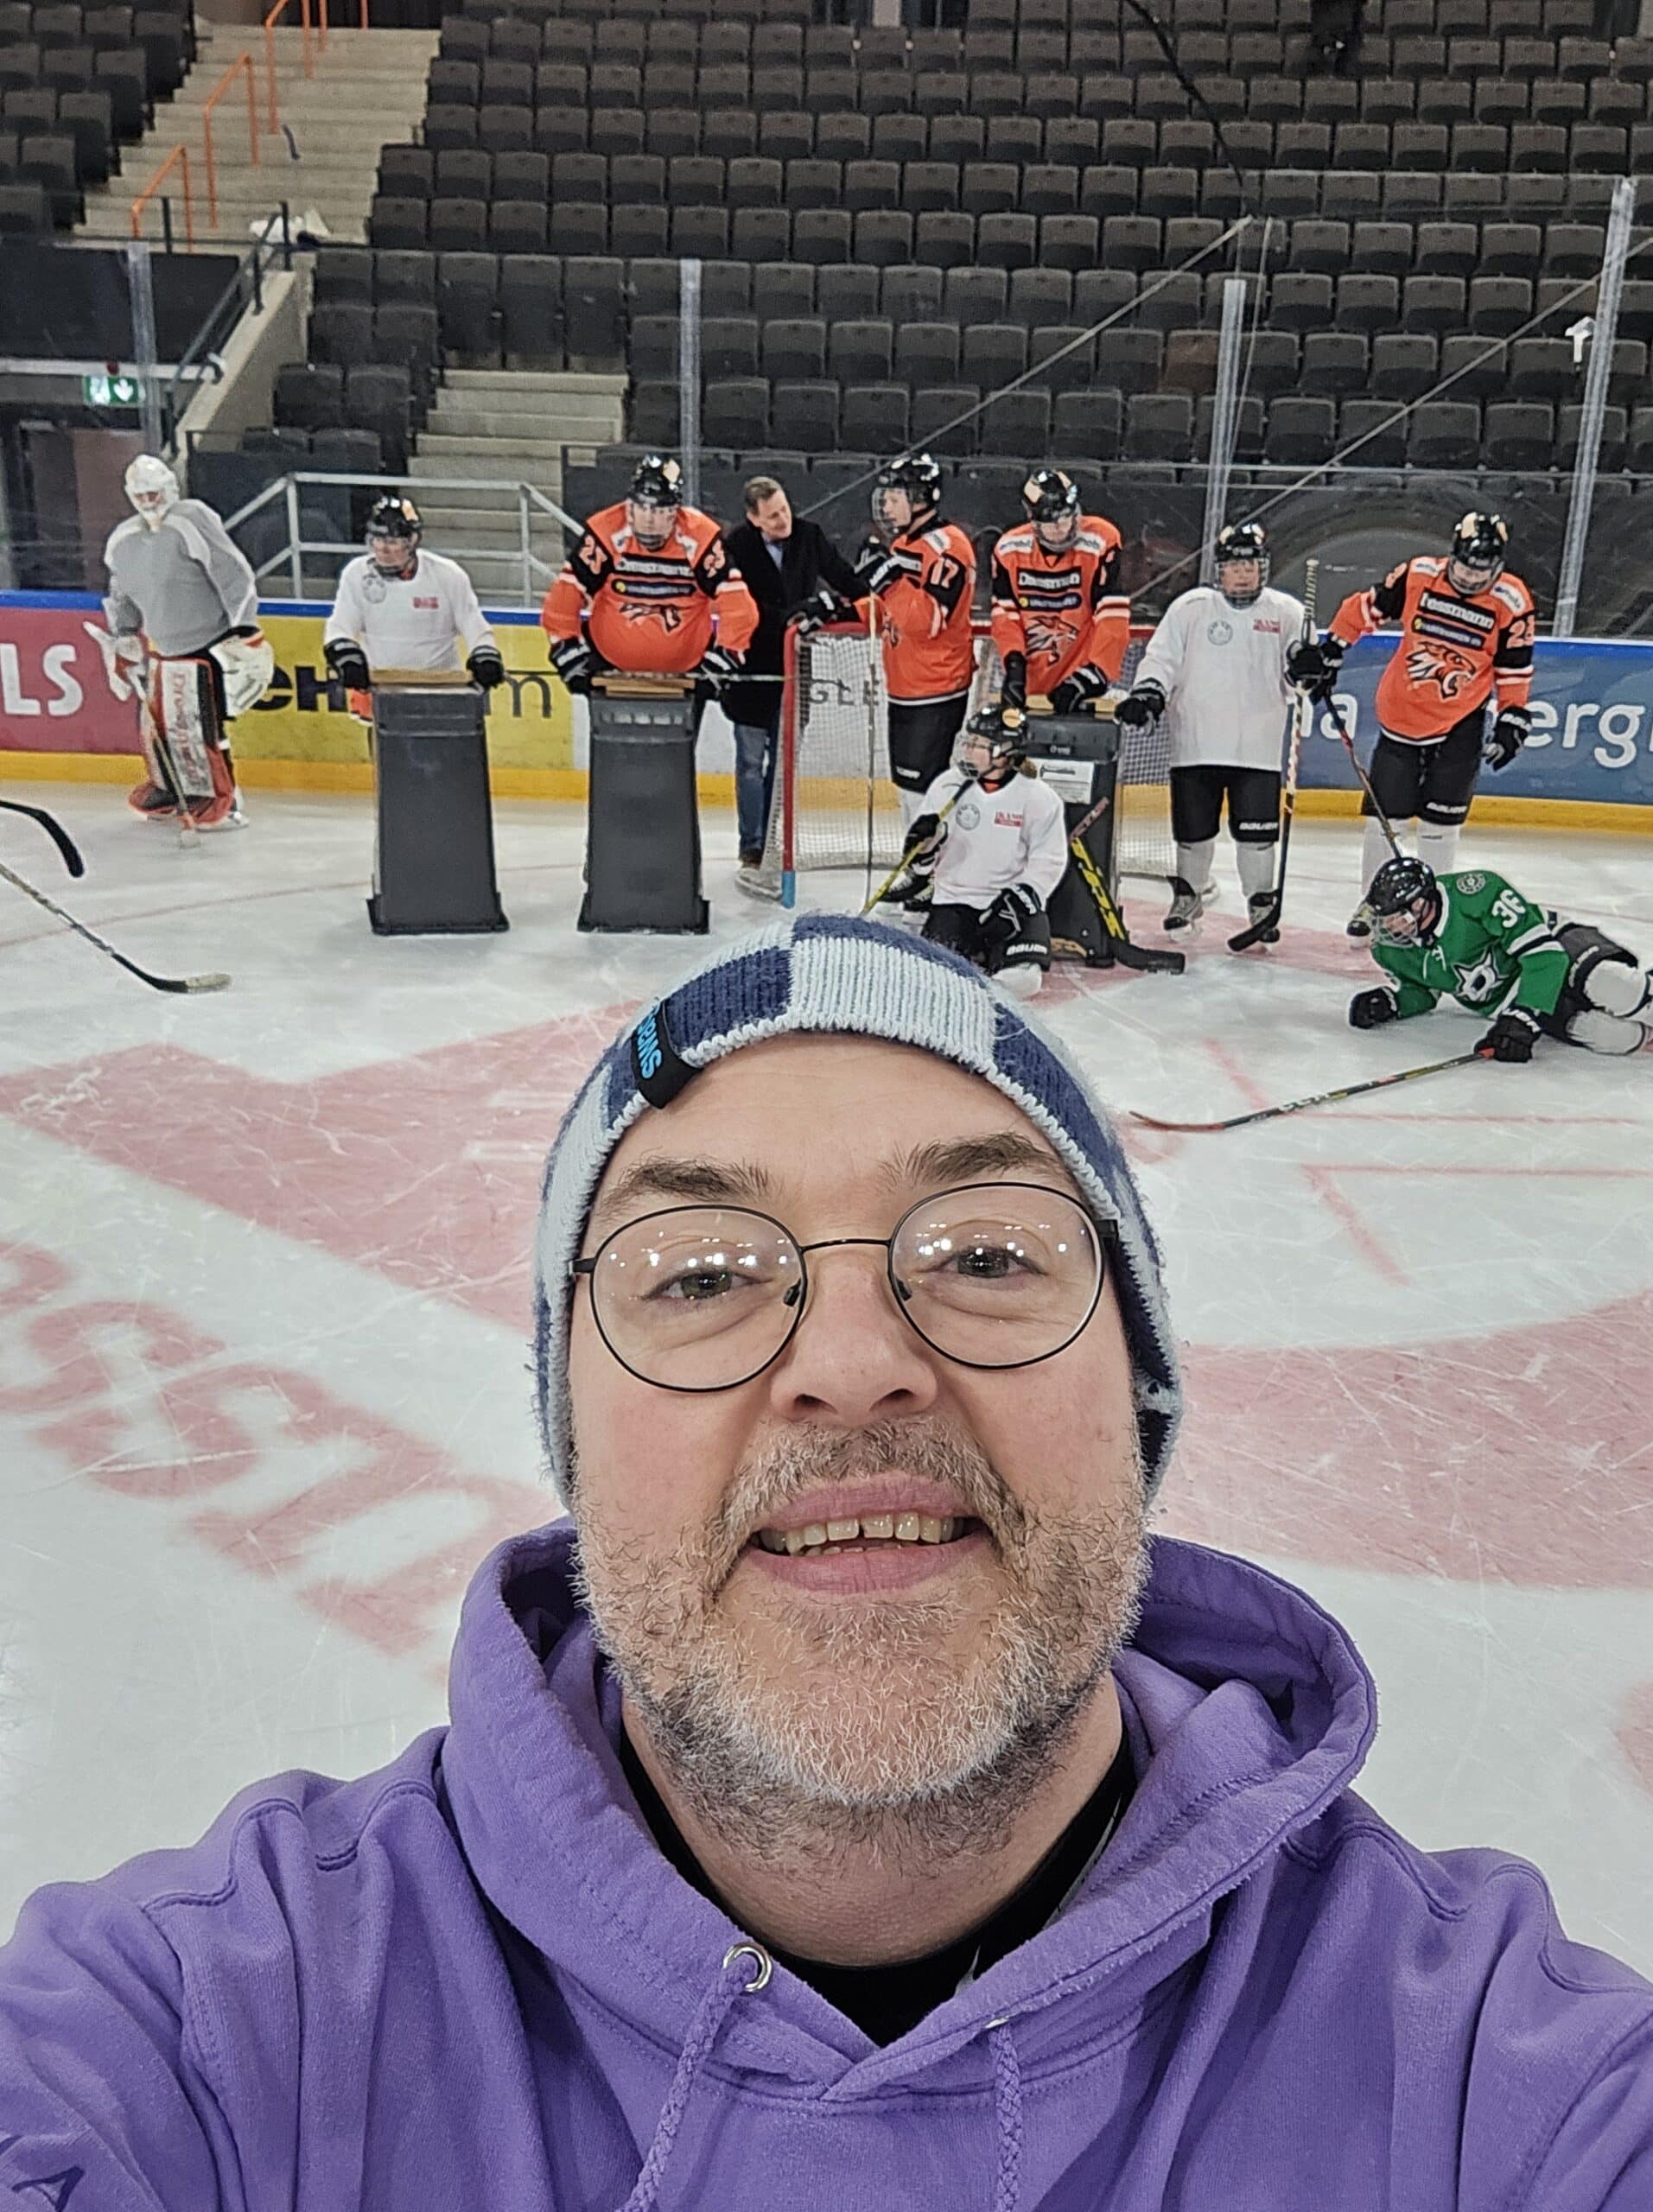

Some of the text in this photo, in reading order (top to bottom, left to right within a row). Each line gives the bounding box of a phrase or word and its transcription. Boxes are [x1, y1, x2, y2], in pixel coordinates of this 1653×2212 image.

[930, 556, 959, 588] 17
[0, 643, 84, 716] LS
[1485, 699, 1653, 768] erg
